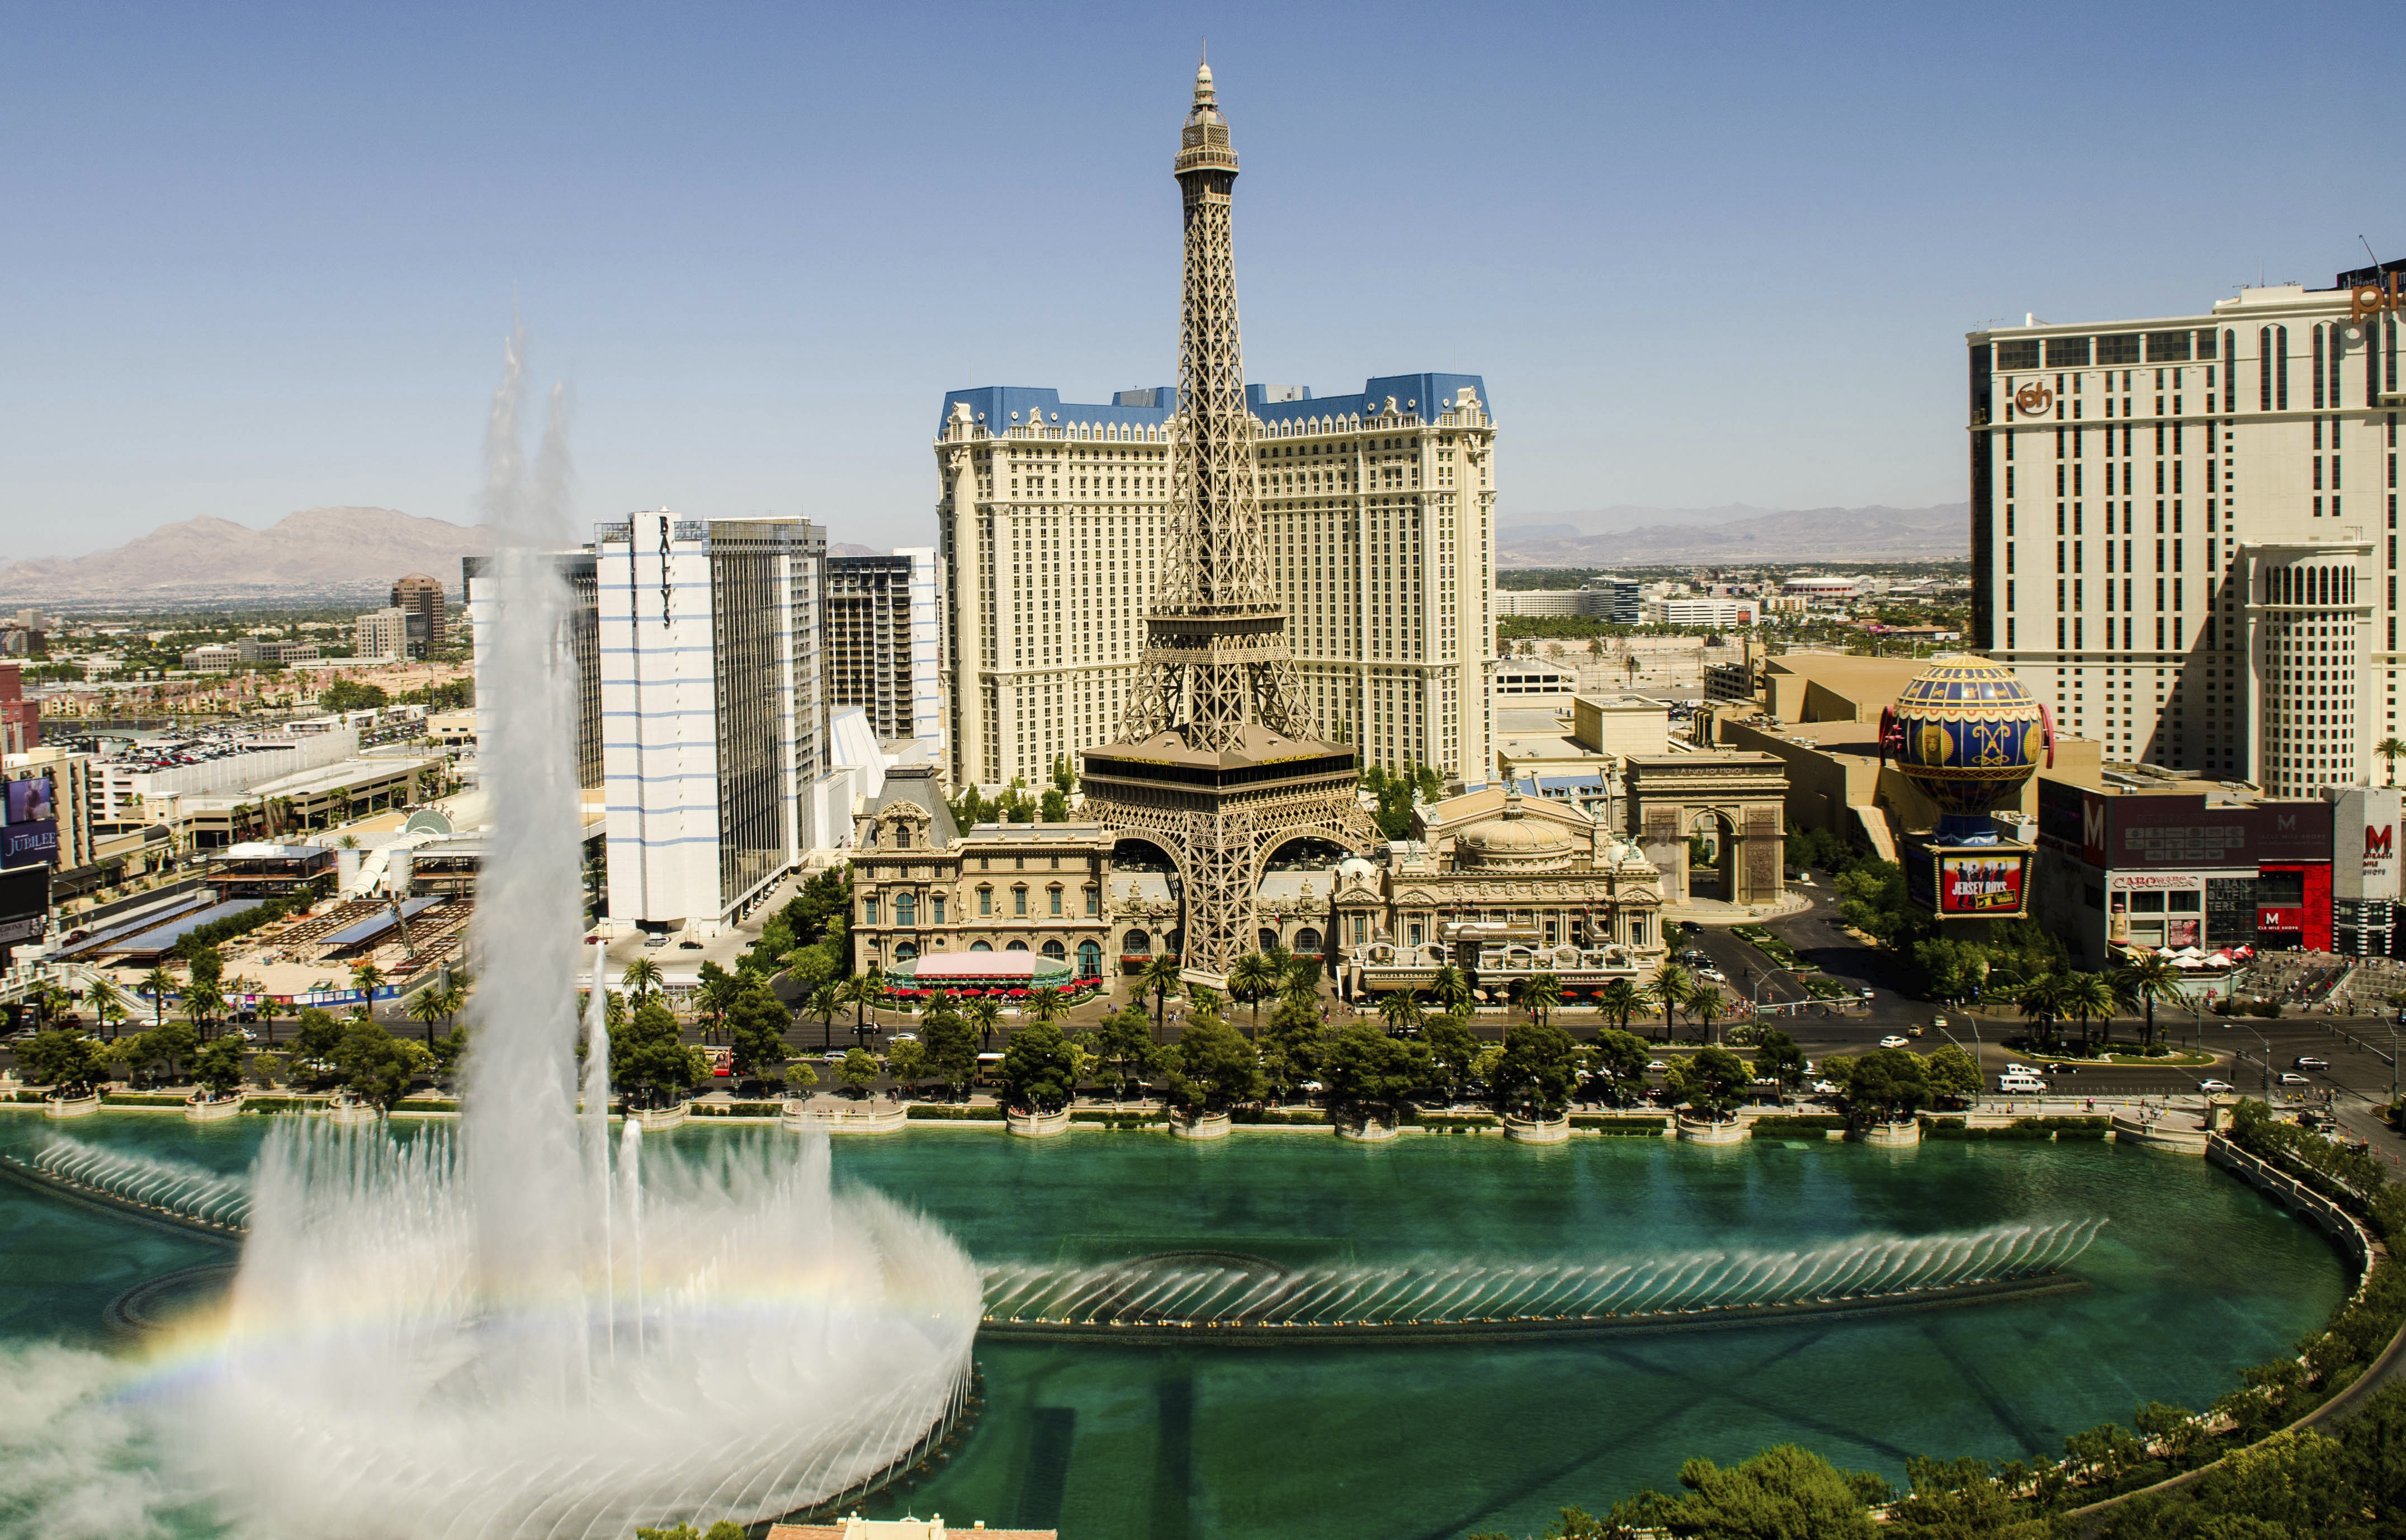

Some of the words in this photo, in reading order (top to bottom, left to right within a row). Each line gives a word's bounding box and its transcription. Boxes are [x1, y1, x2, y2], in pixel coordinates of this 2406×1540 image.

[2352, 271, 2406, 324] pl
[2020, 382, 2052, 408] ph
[659, 516, 671, 627] BALLYS
[2084, 800, 2104, 851] M
[2277, 814, 2295, 831] M
[5, 832, 56, 857] JUBILEE
[2366, 825, 2392, 853] M
[1952, 881, 1984, 895] JERSEY
[1985, 881, 2007, 894] BOYS
[2114, 876, 2156, 888] CABO
[2208, 878, 2248, 889] URBAN
[2208, 901, 2236, 911] TERS
[2266, 913, 2279, 924] M
